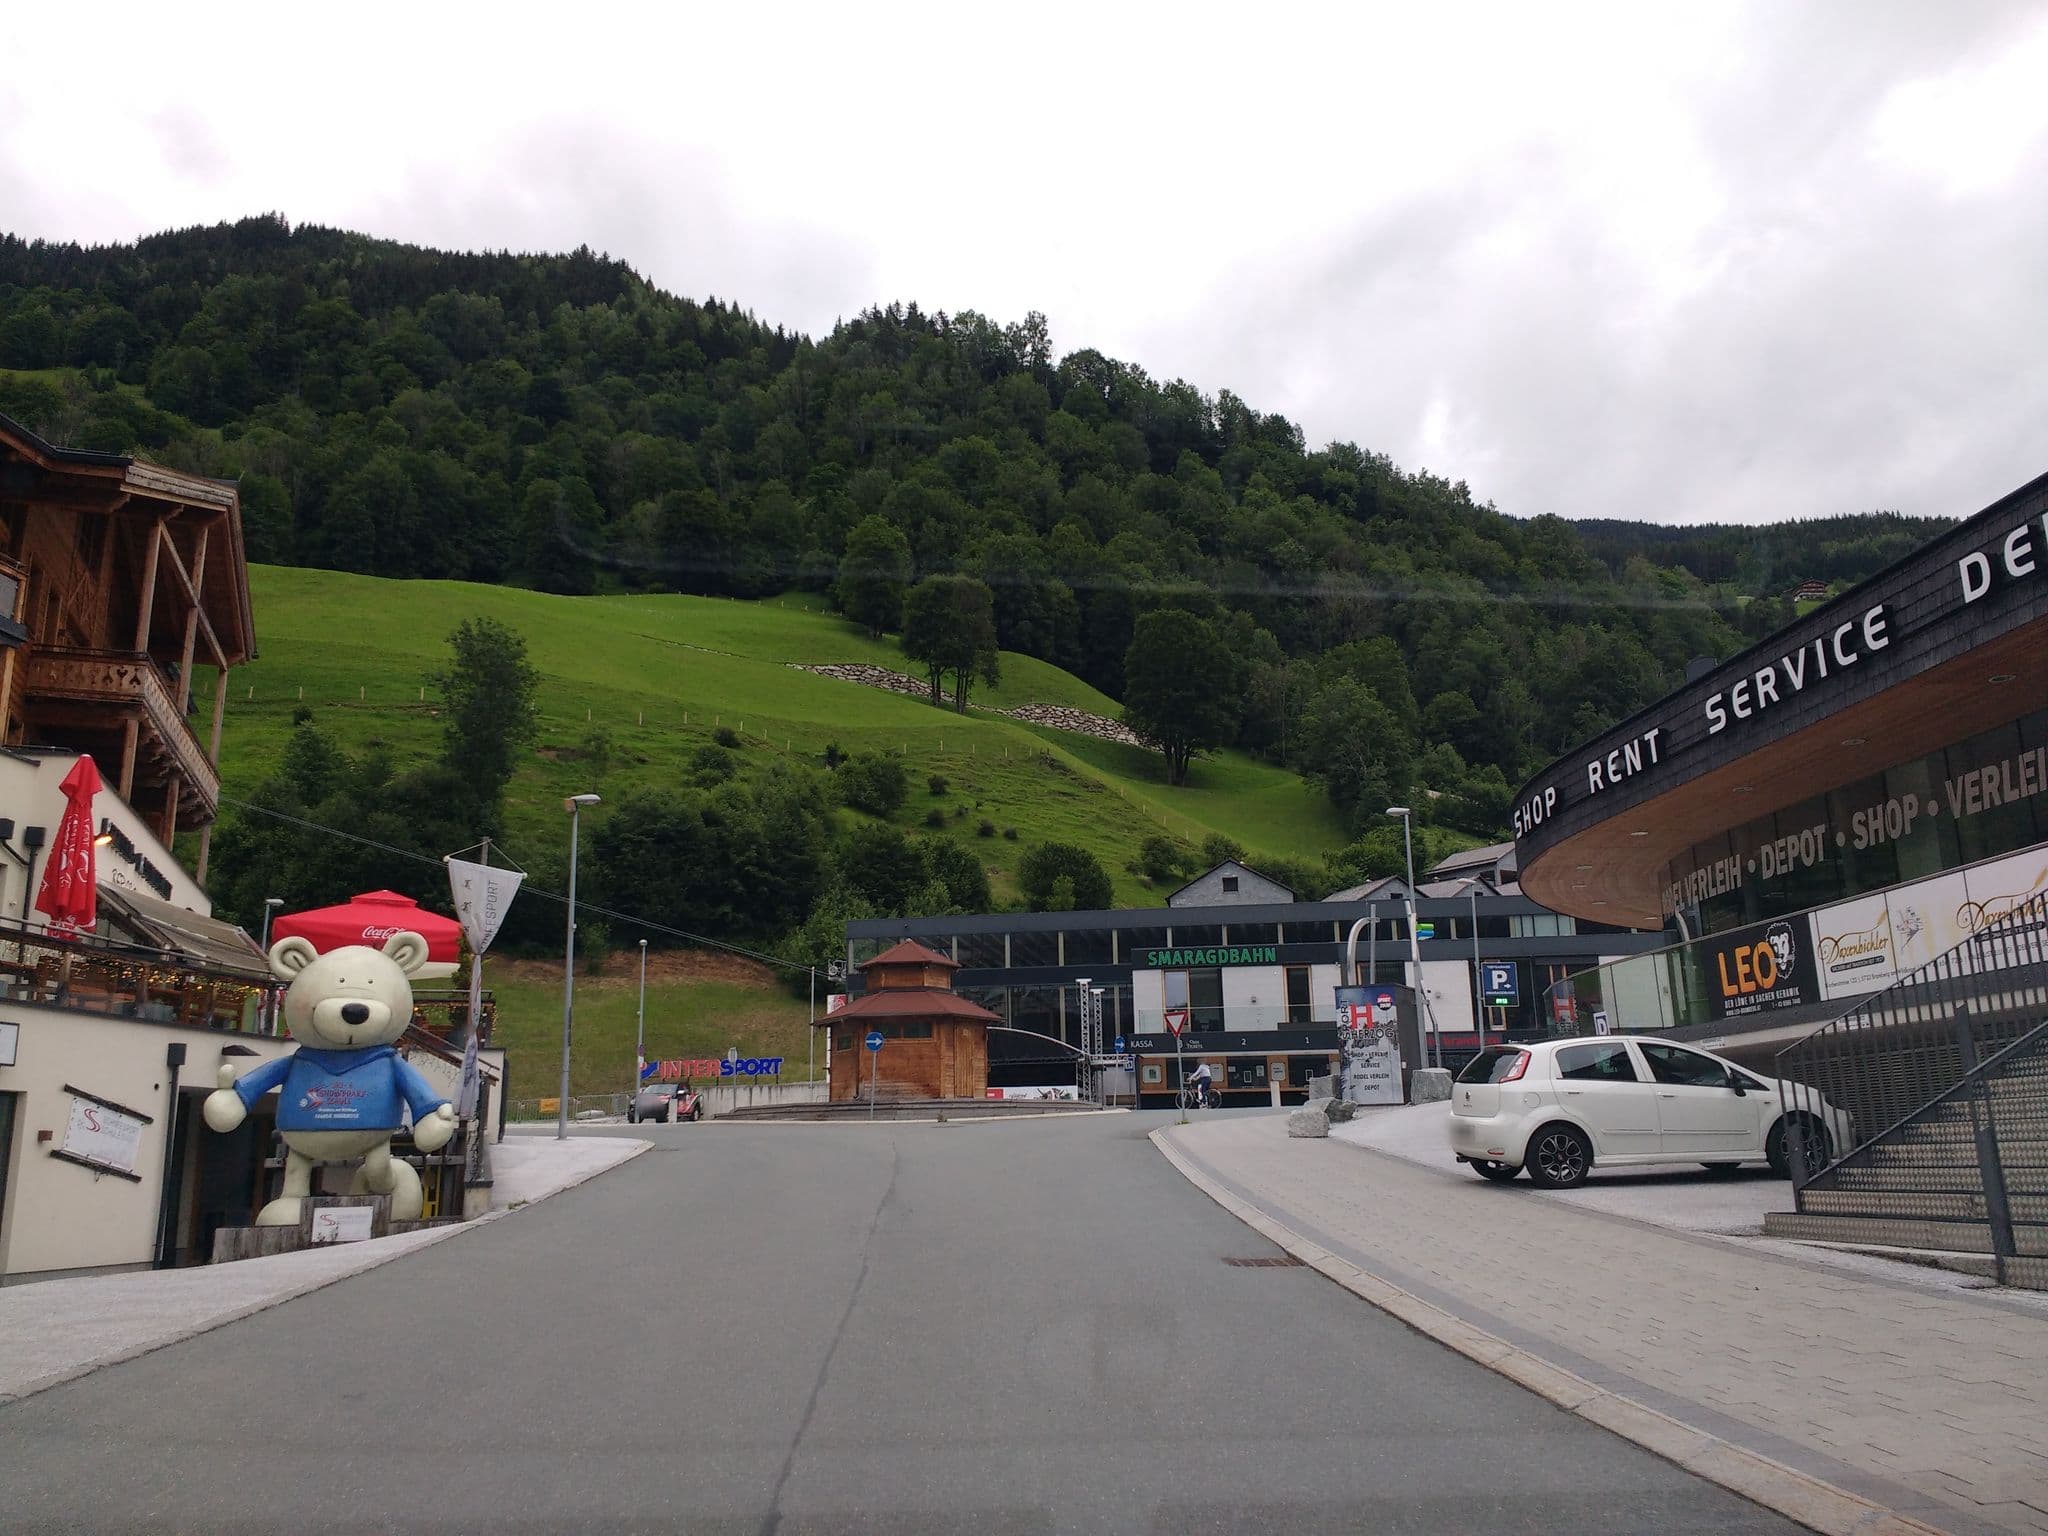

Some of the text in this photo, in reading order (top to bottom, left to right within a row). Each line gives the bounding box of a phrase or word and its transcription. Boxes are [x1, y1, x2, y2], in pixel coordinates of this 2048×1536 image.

[1514, 786, 1557, 839] SHOP
[1588, 728, 1660, 794] RENT
[1705, 604, 1889, 735] SERVICE
[1686, 854, 1742, 905] VERLEIH
[1760, 823, 1826, 880] DEPOT
[1852, 793, 1919, 850] SHOP
[1148, 947, 1277, 966] SMARAGDBAHN
[1718, 941, 1777, 997] LEO
[1491, 970, 1507, 989] P
[1130, 1039, 1154, 1049] KASSA
[1241, 1038, 1247, 1046] 2
[1305, 1036, 1310, 1044] 1
[1351, 1028, 1394, 1041] HERZOG
[660, 1057, 784, 1080] INTERSPORT
